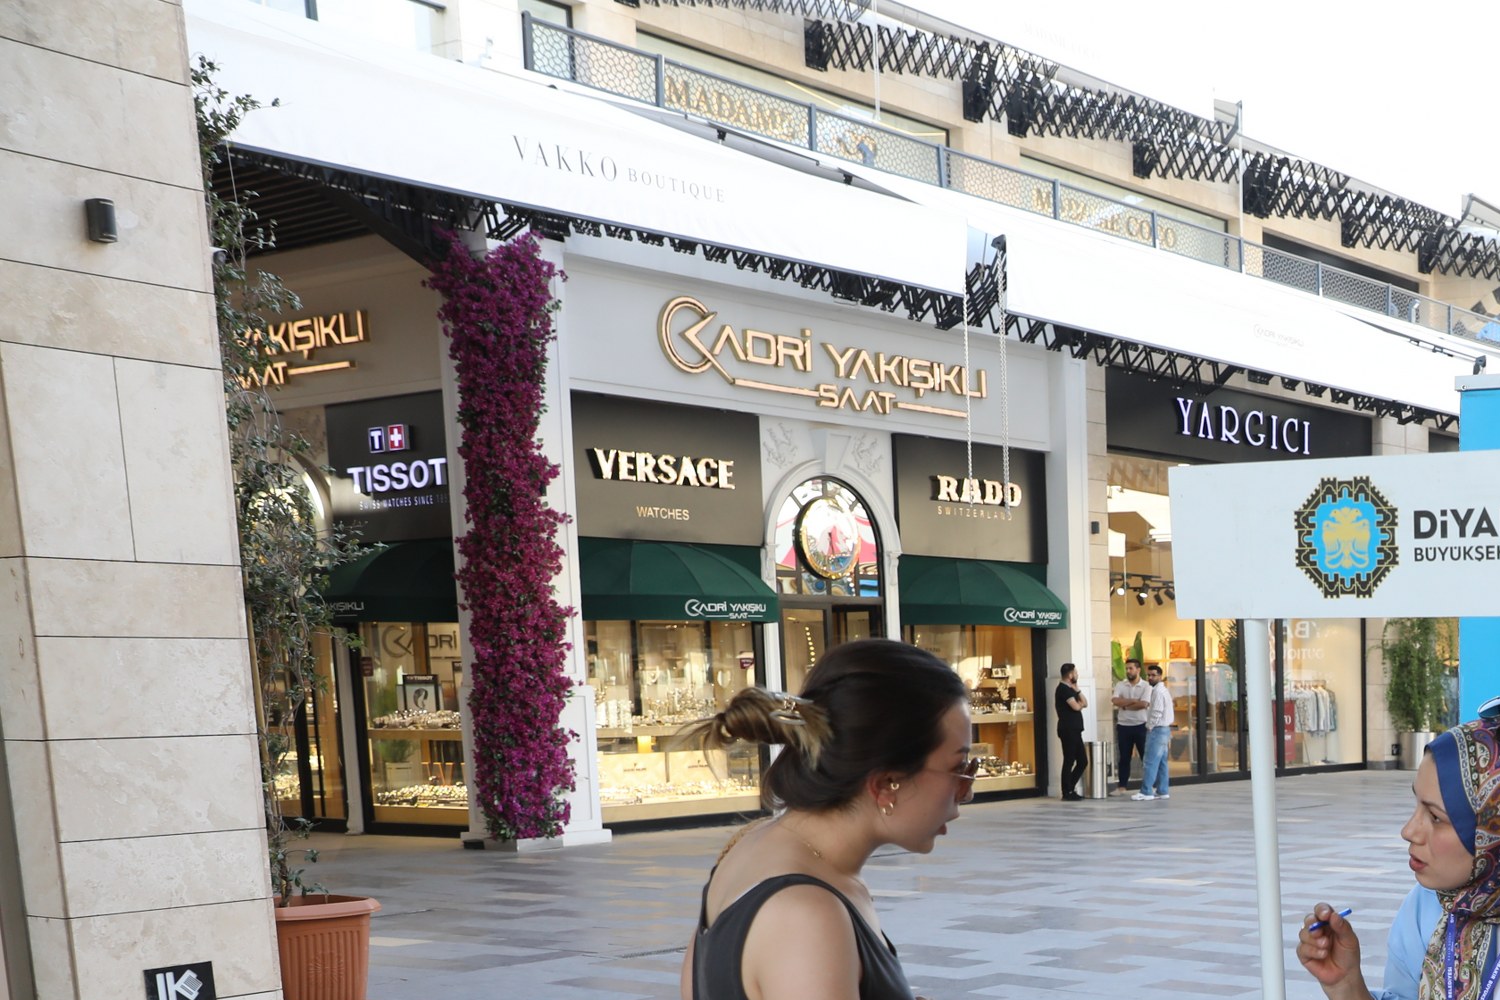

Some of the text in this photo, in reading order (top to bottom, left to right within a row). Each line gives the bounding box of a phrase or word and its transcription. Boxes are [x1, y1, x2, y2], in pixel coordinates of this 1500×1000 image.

[512, 134, 726, 204] VAKKO BOUTIQUE
[236, 310, 365, 361] AKIŞIKLI
[821, 341, 988, 399] YAKIŞIKLI
[817, 384, 897, 415] SAAT
[1176, 397, 1311, 456] YARGICI
[346, 457, 447, 494] TISSOT
[593, 447, 736, 490] VERSACE
[383, 497, 413, 509] WATCHES
[414, 495, 434, 507] SINCE
[636, 506, 690, 521] WATCHES
